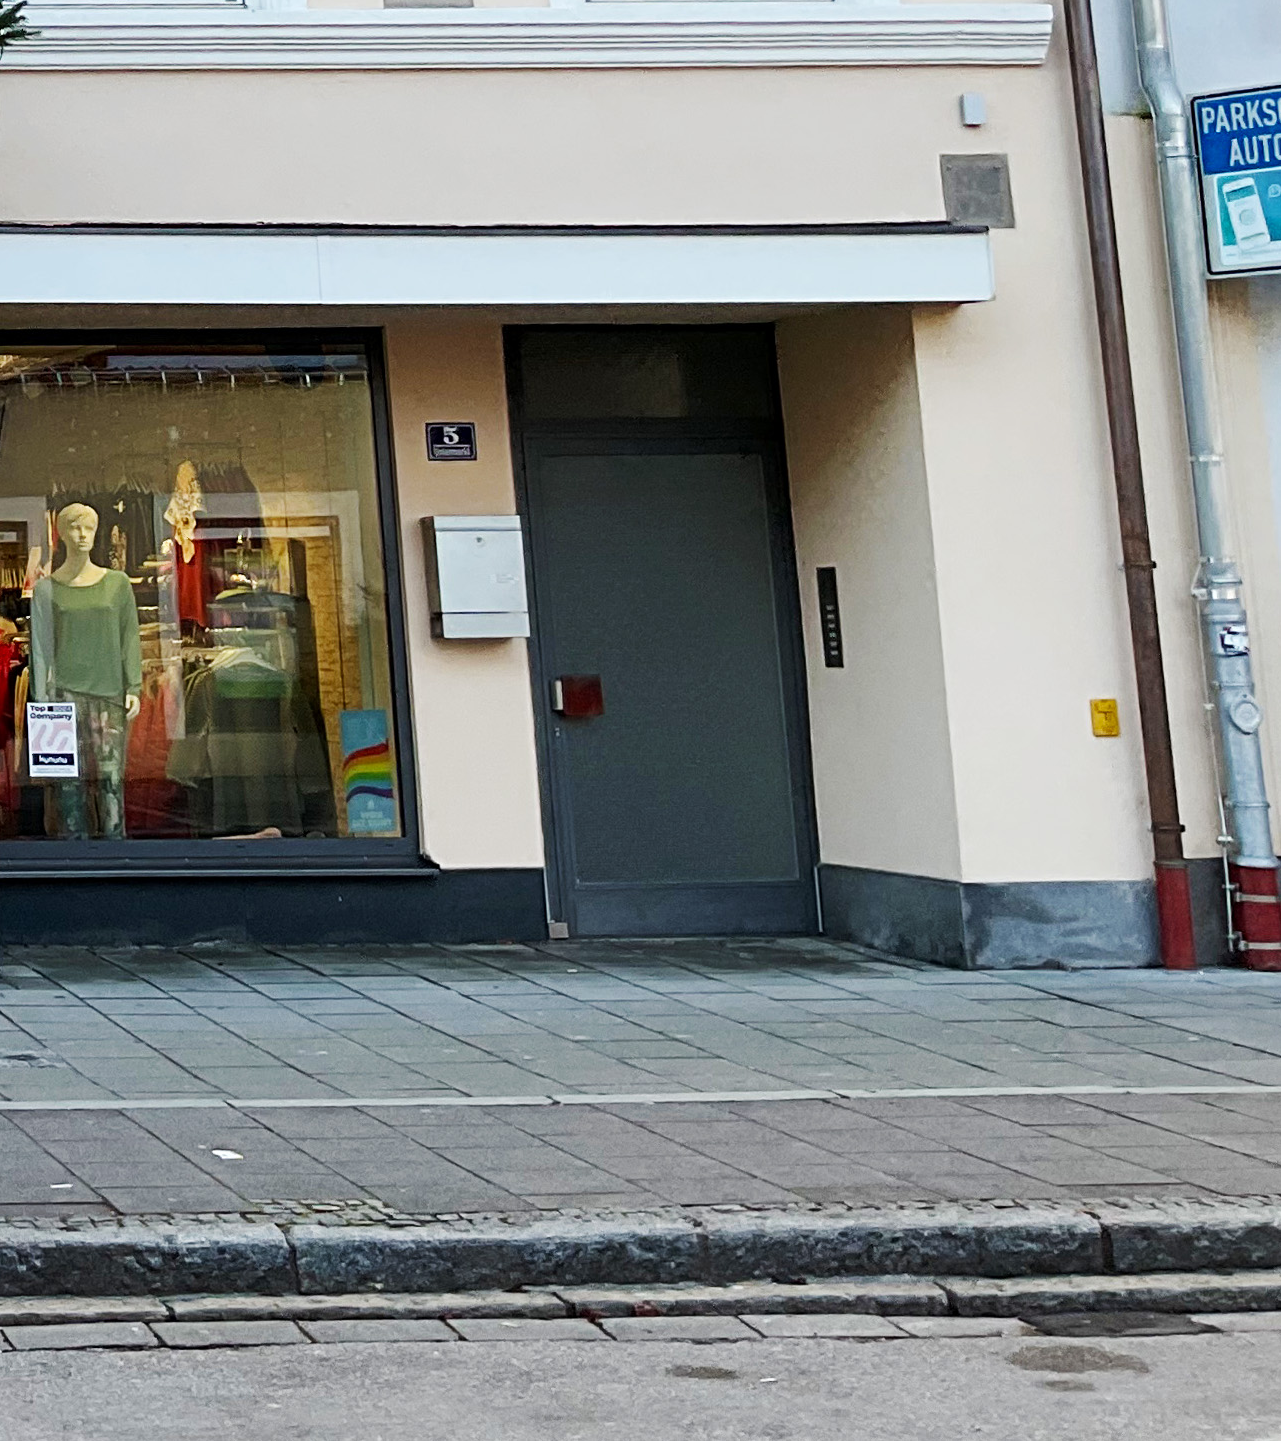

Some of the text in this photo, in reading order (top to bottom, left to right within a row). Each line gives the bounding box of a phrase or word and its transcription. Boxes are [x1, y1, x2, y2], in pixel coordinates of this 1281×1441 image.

[1201, 98, 1281, 135] PARKS
[442, 426, 460, 445] 5
[30, 712, 72, 721] Company
